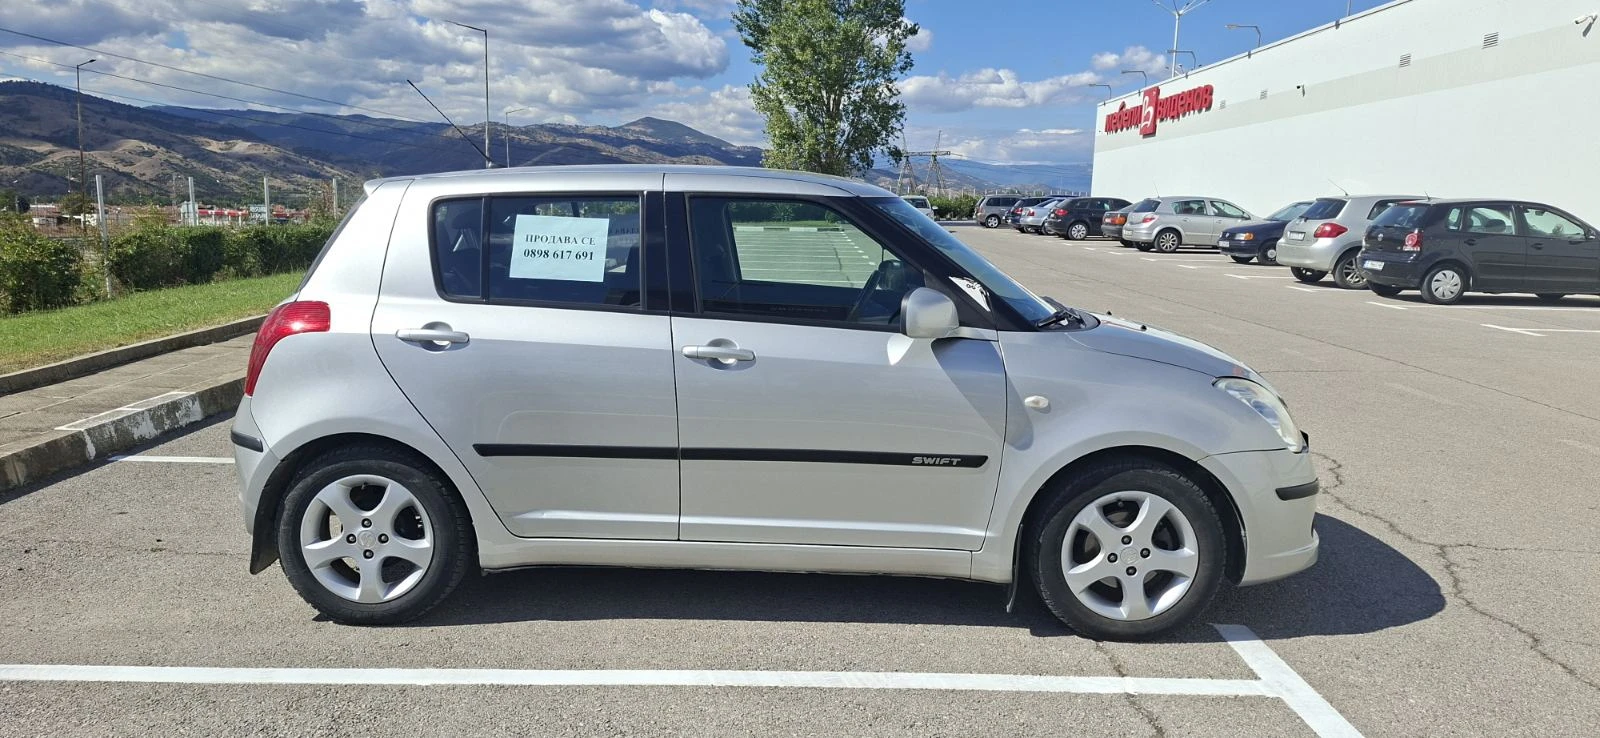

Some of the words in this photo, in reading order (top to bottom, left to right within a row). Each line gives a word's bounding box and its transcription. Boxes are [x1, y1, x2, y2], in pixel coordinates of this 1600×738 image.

[525, 234, 578, 245] ПРОДАВА
[581, 236, 596, 246] СЕ
[523, 248, 550, 258] 0898
[552, 249, 572, 260] 617
[575, 250, 594, 261] 691
[911, 456, 962, 466] SWIFT
